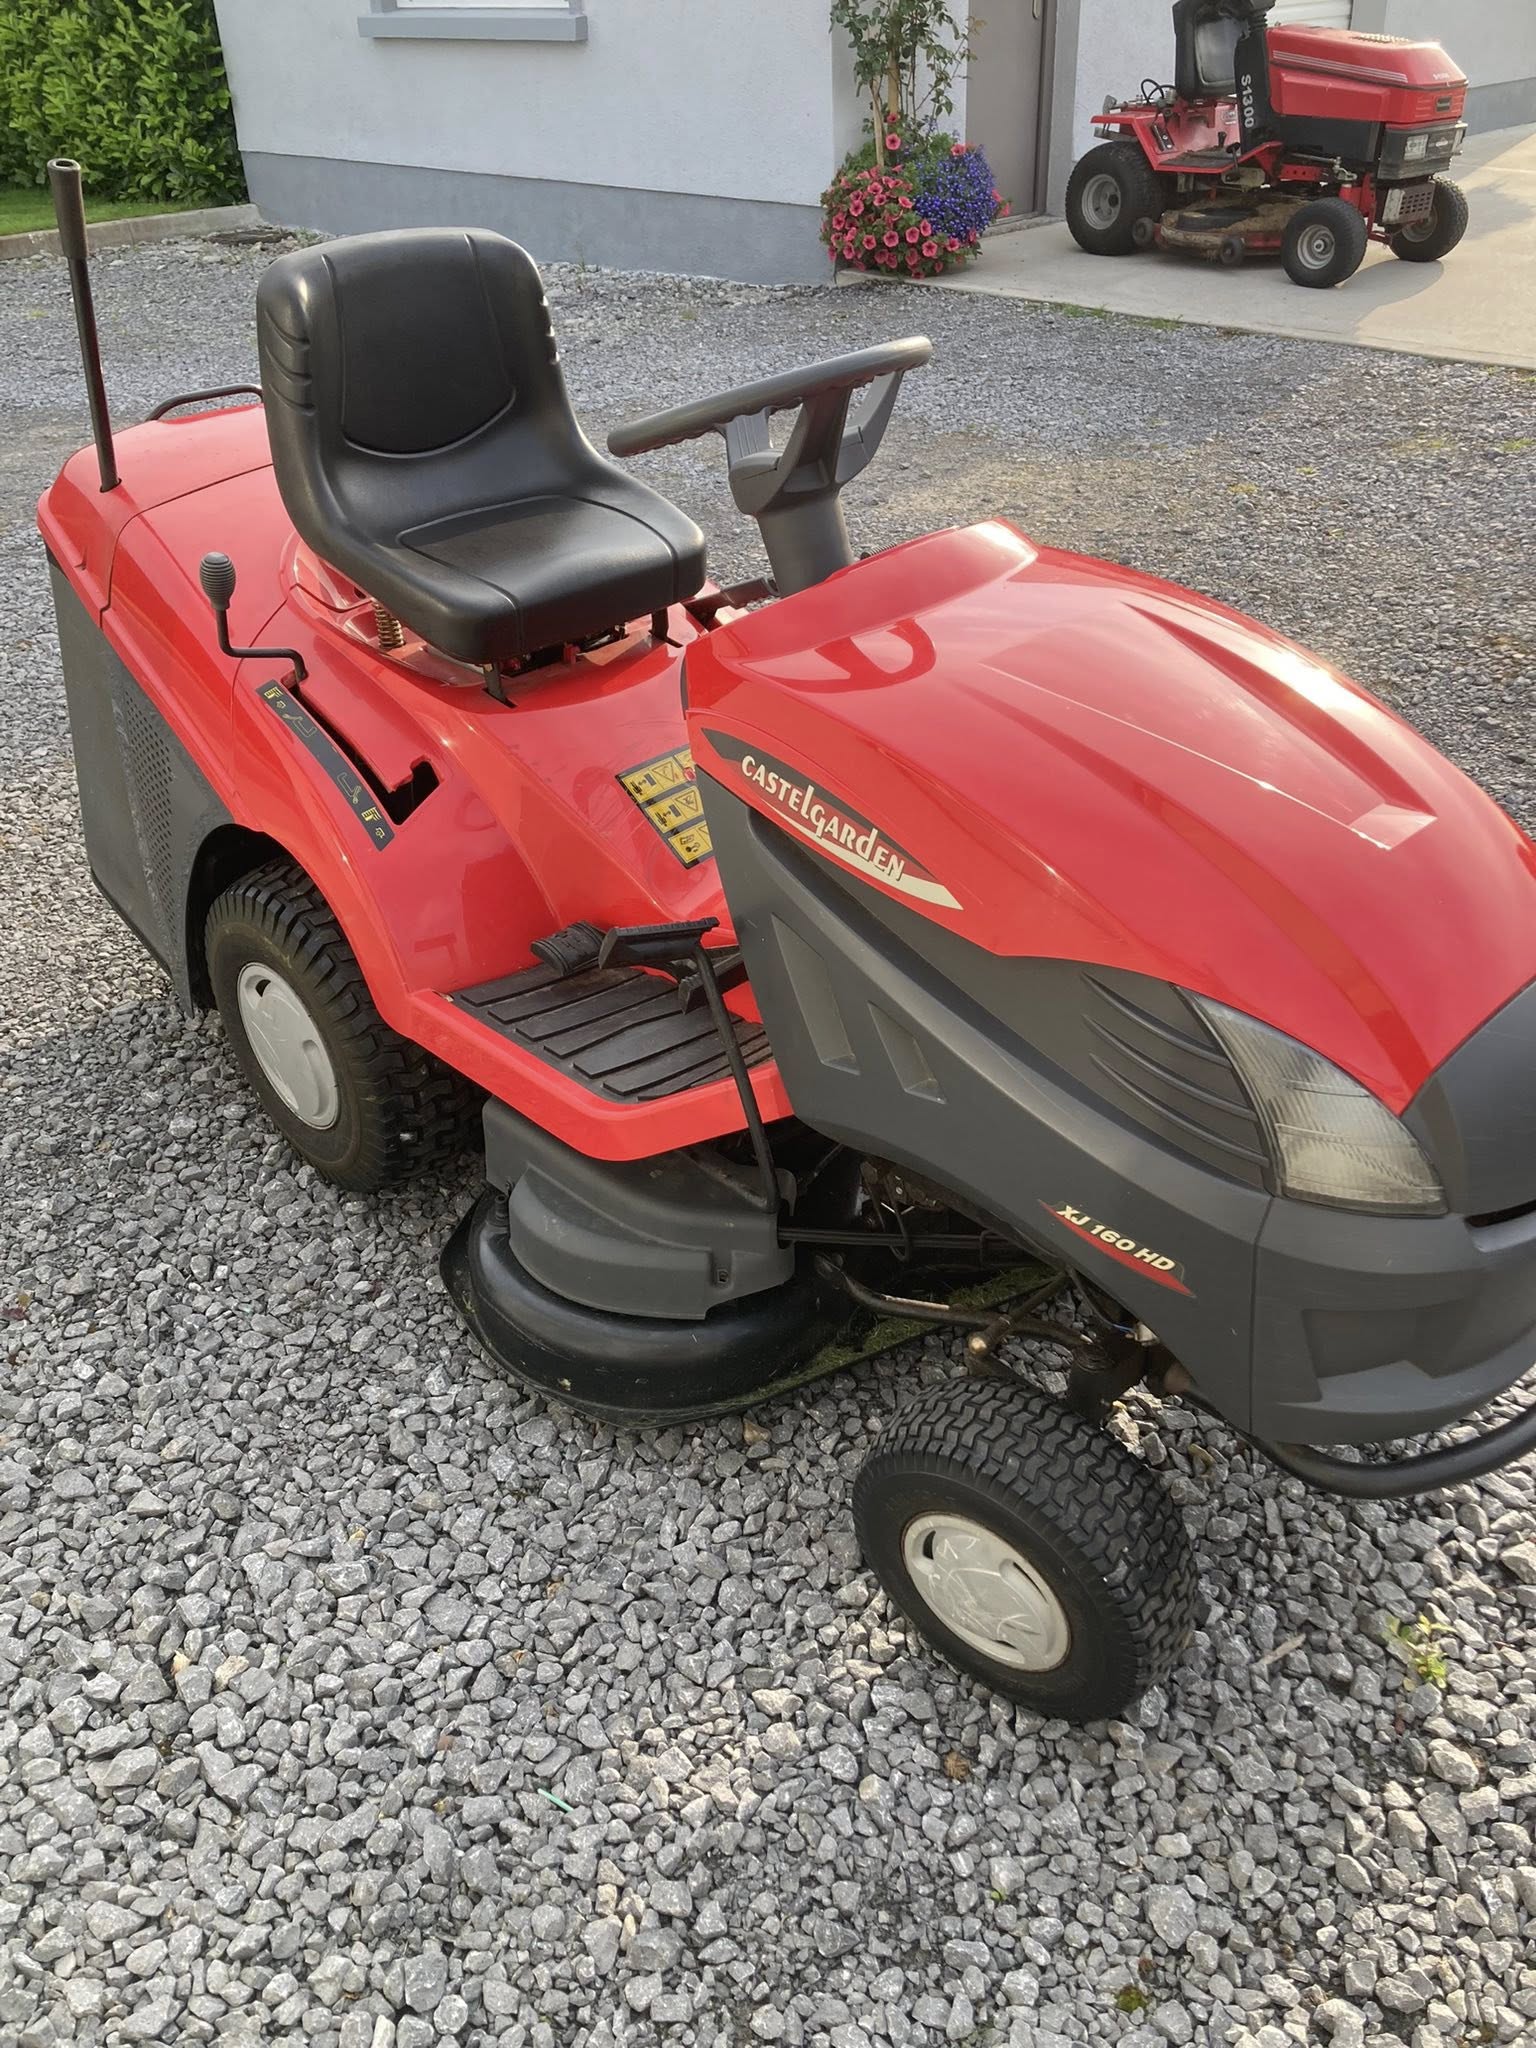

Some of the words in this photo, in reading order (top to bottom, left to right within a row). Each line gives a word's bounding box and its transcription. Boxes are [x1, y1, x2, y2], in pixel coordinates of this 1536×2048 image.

[1241, 74, 1254, 128] S1300
[1056, 1205, 1091, 1226] XJ
[1090, 1224, 1136, 1251] 160
[1133, 1247, 1176, 1271] HD
